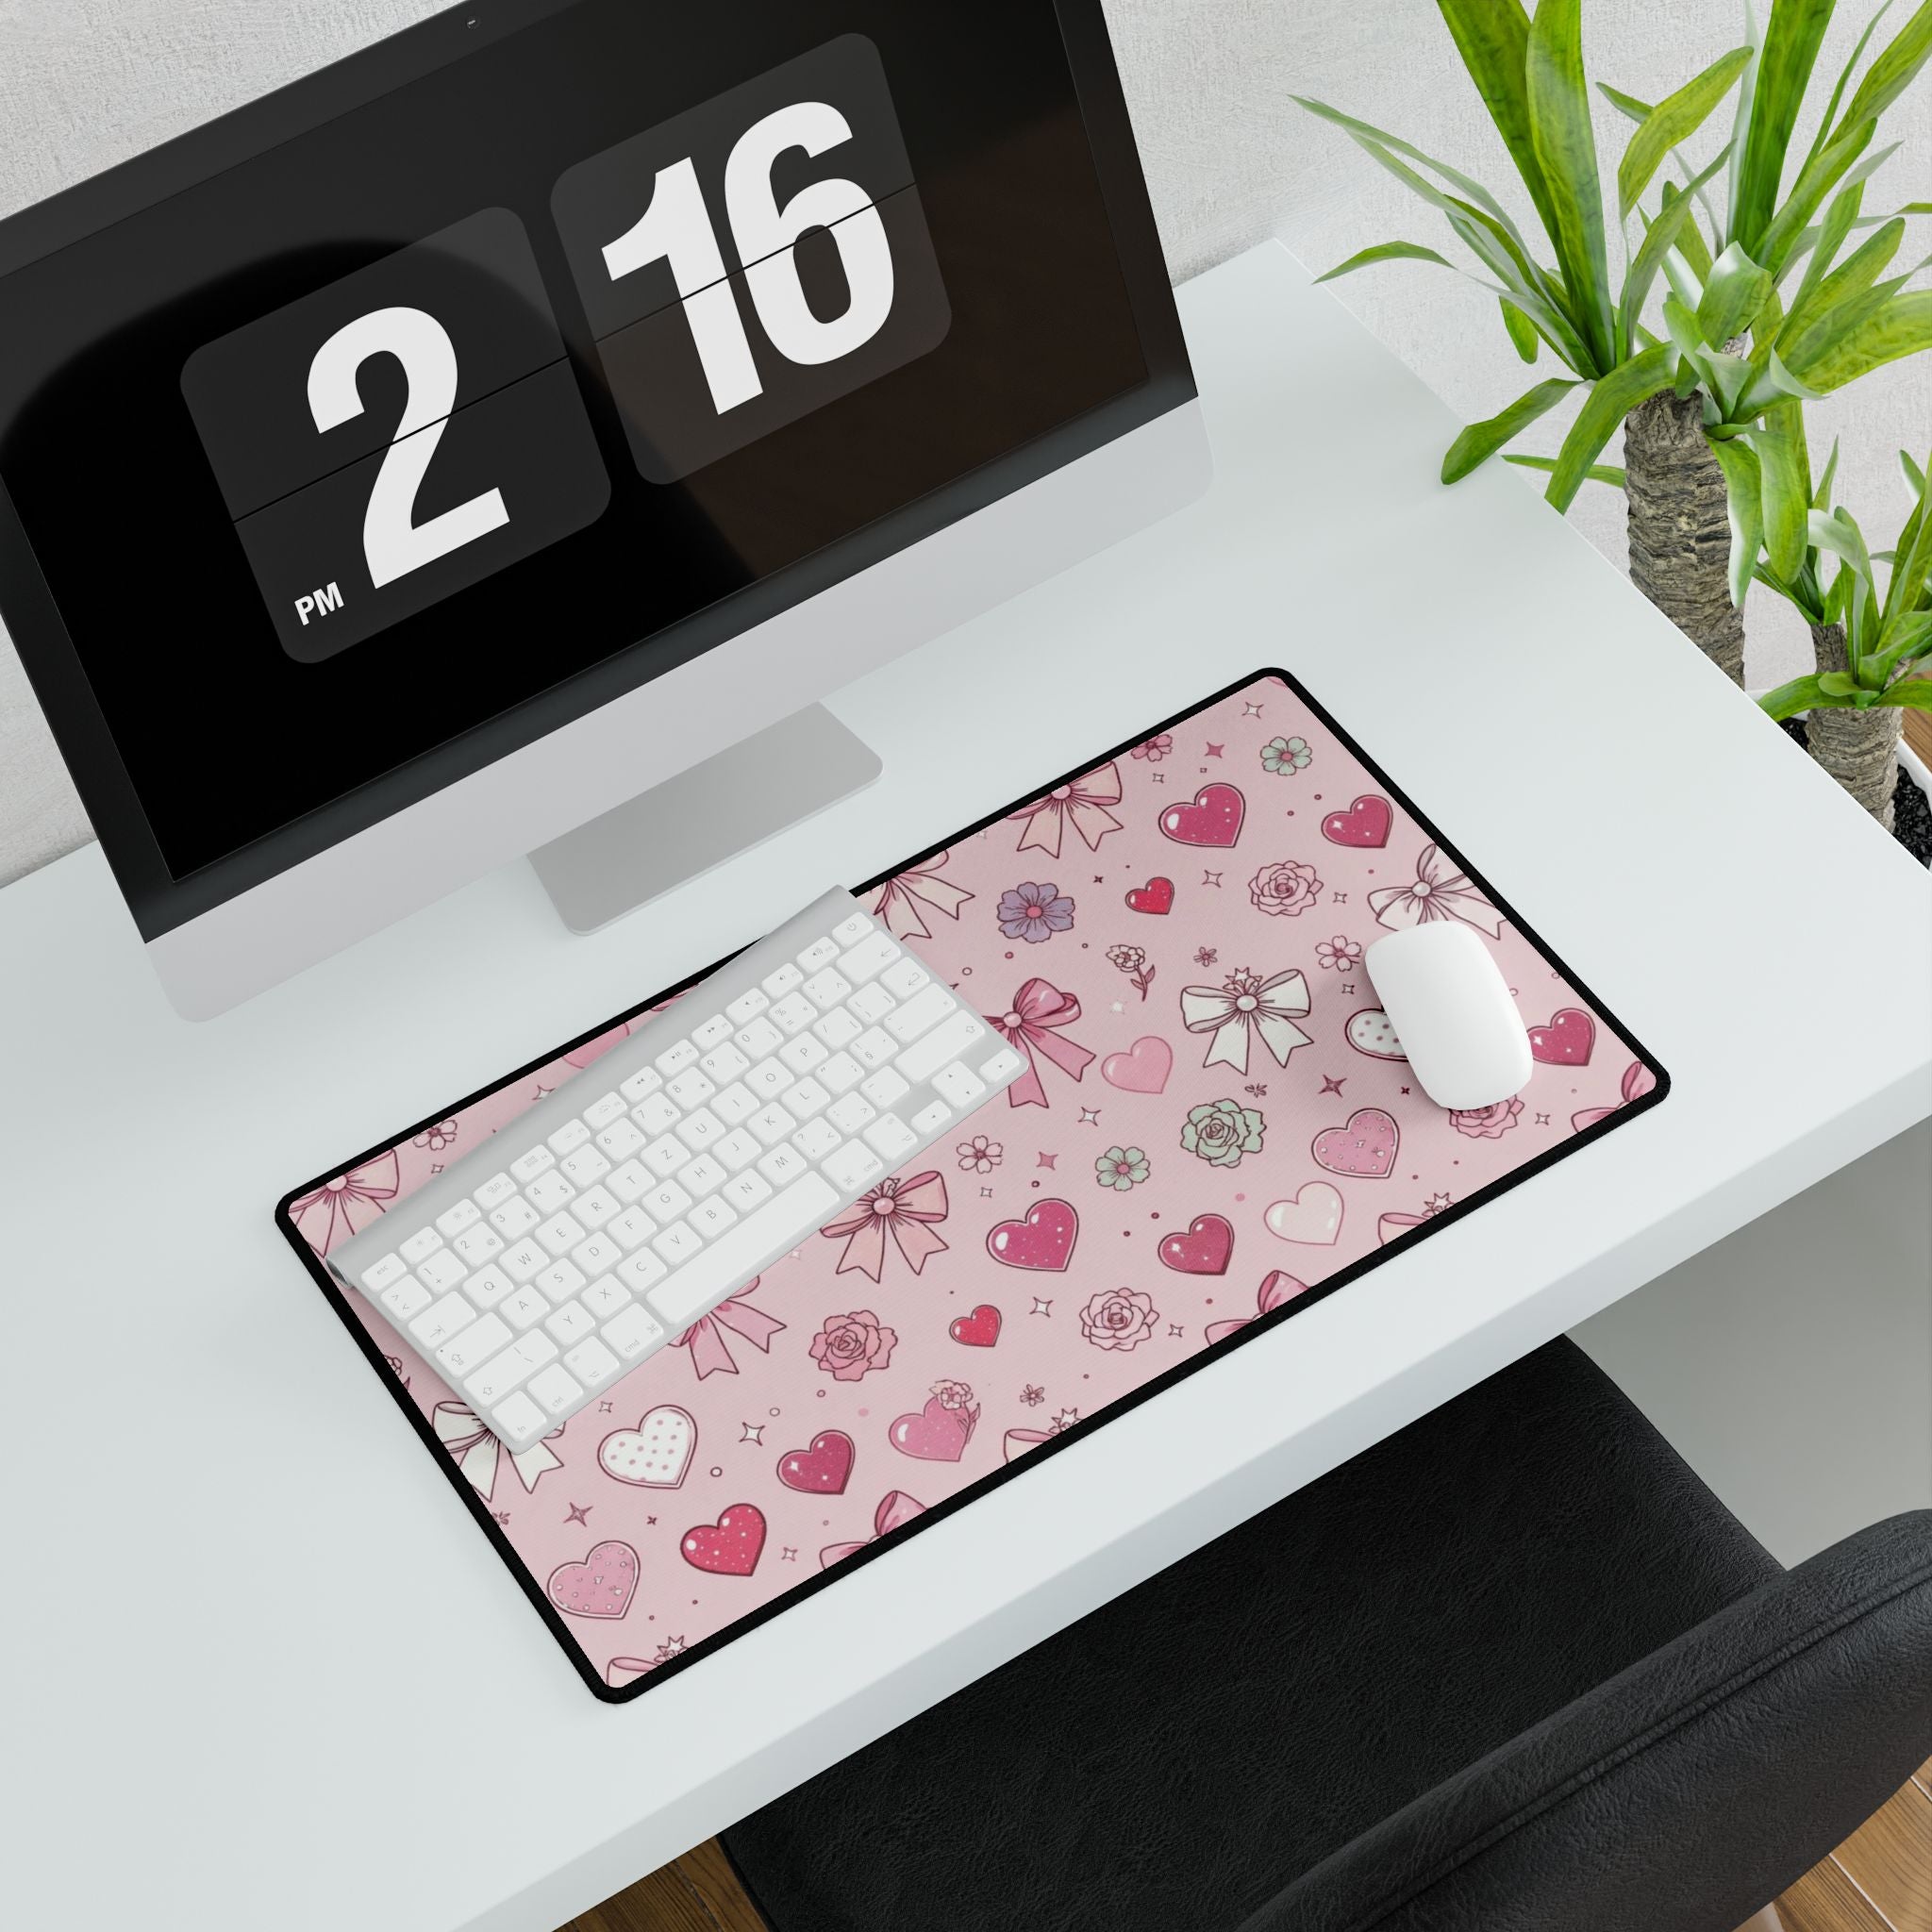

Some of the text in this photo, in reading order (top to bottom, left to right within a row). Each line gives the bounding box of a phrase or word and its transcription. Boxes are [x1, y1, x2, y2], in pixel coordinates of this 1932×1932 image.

[308, 102, 893, 589] 2 16
[295, 582, 344, 625] PM
[799, 1047, 808, 1058] P
[706, 1058, 716, 1069] 9
[672, 1084, 682, 1094] 8
[799, 1091, 810, 1101] L
[636, 1109, 645, 1120] 7
[764, 1115, 776, 1126] K
[695, 1123, 708, 1134] U
[603, 1135, 613, 1145] 6
[732, 1141, 741, 1152] J
[661, 1149, 673, 1160] Z
[566, 1161, 576, 1172] 5
[774, 1156, 790, 1169] M
[693, 1167, 707, 1178] H
[625, 1175, 637, 1185] T
[533, 1187, 542, 1196] 4
[741, 1182, 753, 1194] N
[659, 1193, 672, 1204] G
[591, 1202, 603, 1212] R
[495, 1213, 506, 1224] 3
[706, 1209, 717, 1220] B
[625, 1220, 635, 1230] F
[556, 1228, 567, 1238] E
[459, 1239, 471, 1250] 2
[670, 1235, 680, 1245] V
[588, 1246, 600, 1257] D
[518, 1253, 532, 1265] W
[635, 1261, 647, 1273] C
[553, 1274, 564, 1284] S
[483, 1281, 496, 1291] Q
[599, 1288, 612, 1300] X
[518, 1300, 529, 1310] A
[562, 1315, 574, 1325] Y
